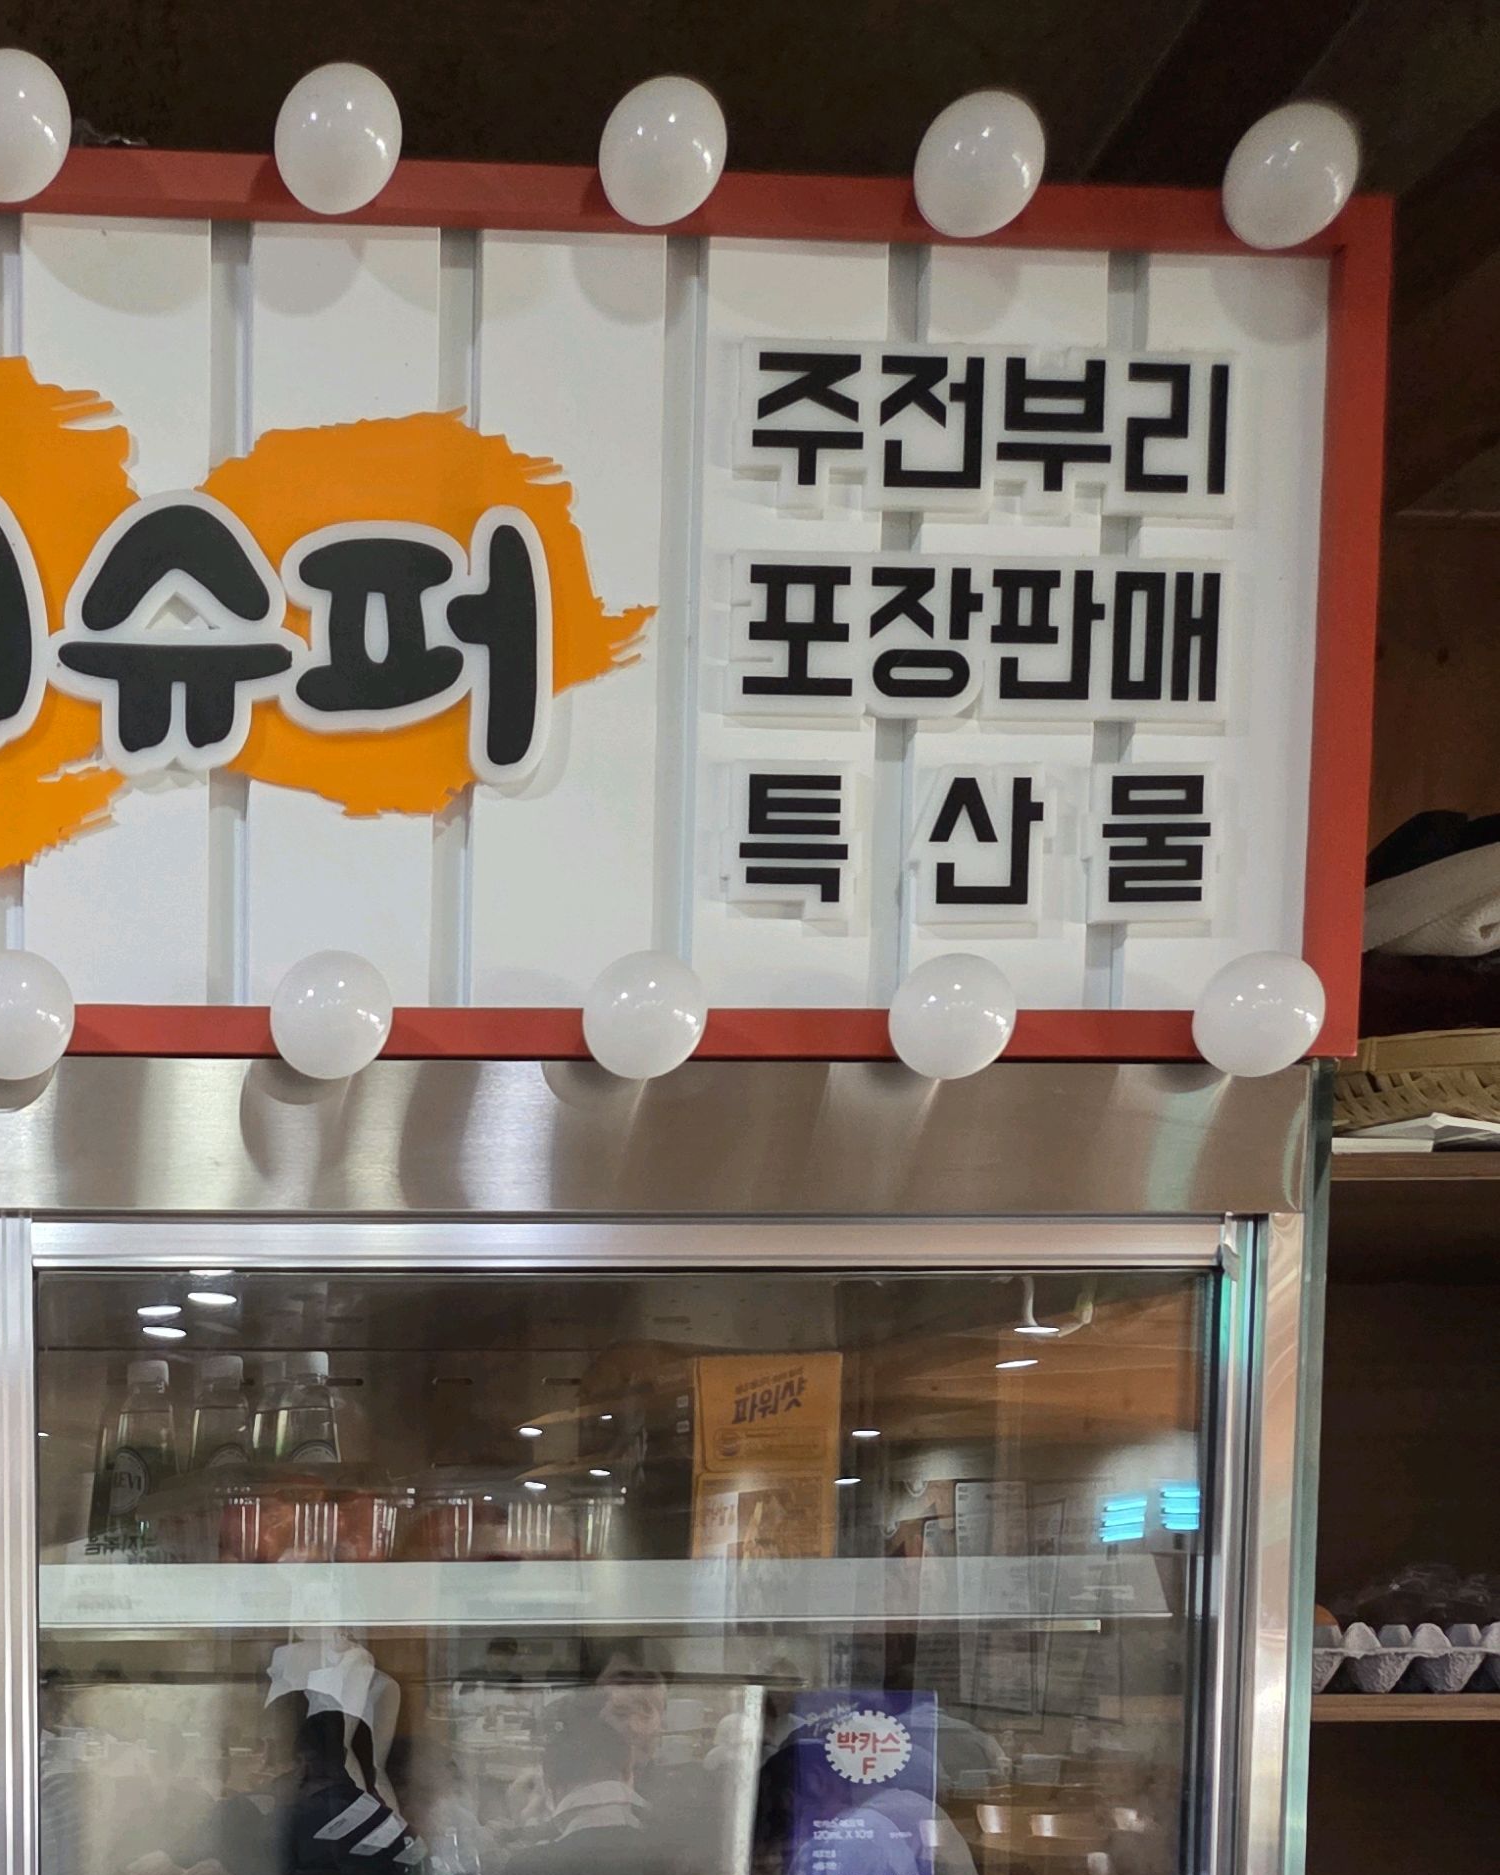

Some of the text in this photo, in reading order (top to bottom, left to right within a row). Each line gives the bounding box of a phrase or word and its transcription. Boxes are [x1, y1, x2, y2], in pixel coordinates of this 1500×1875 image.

[751, 351, 1230, 495] 주전부리
[741, 563, 1221, 703] 포장판매
[738, 773, 1212, 905] 특산물
[836, 1731, 901, 1755] 박카스
[862, 1757, 877, 1776] F
